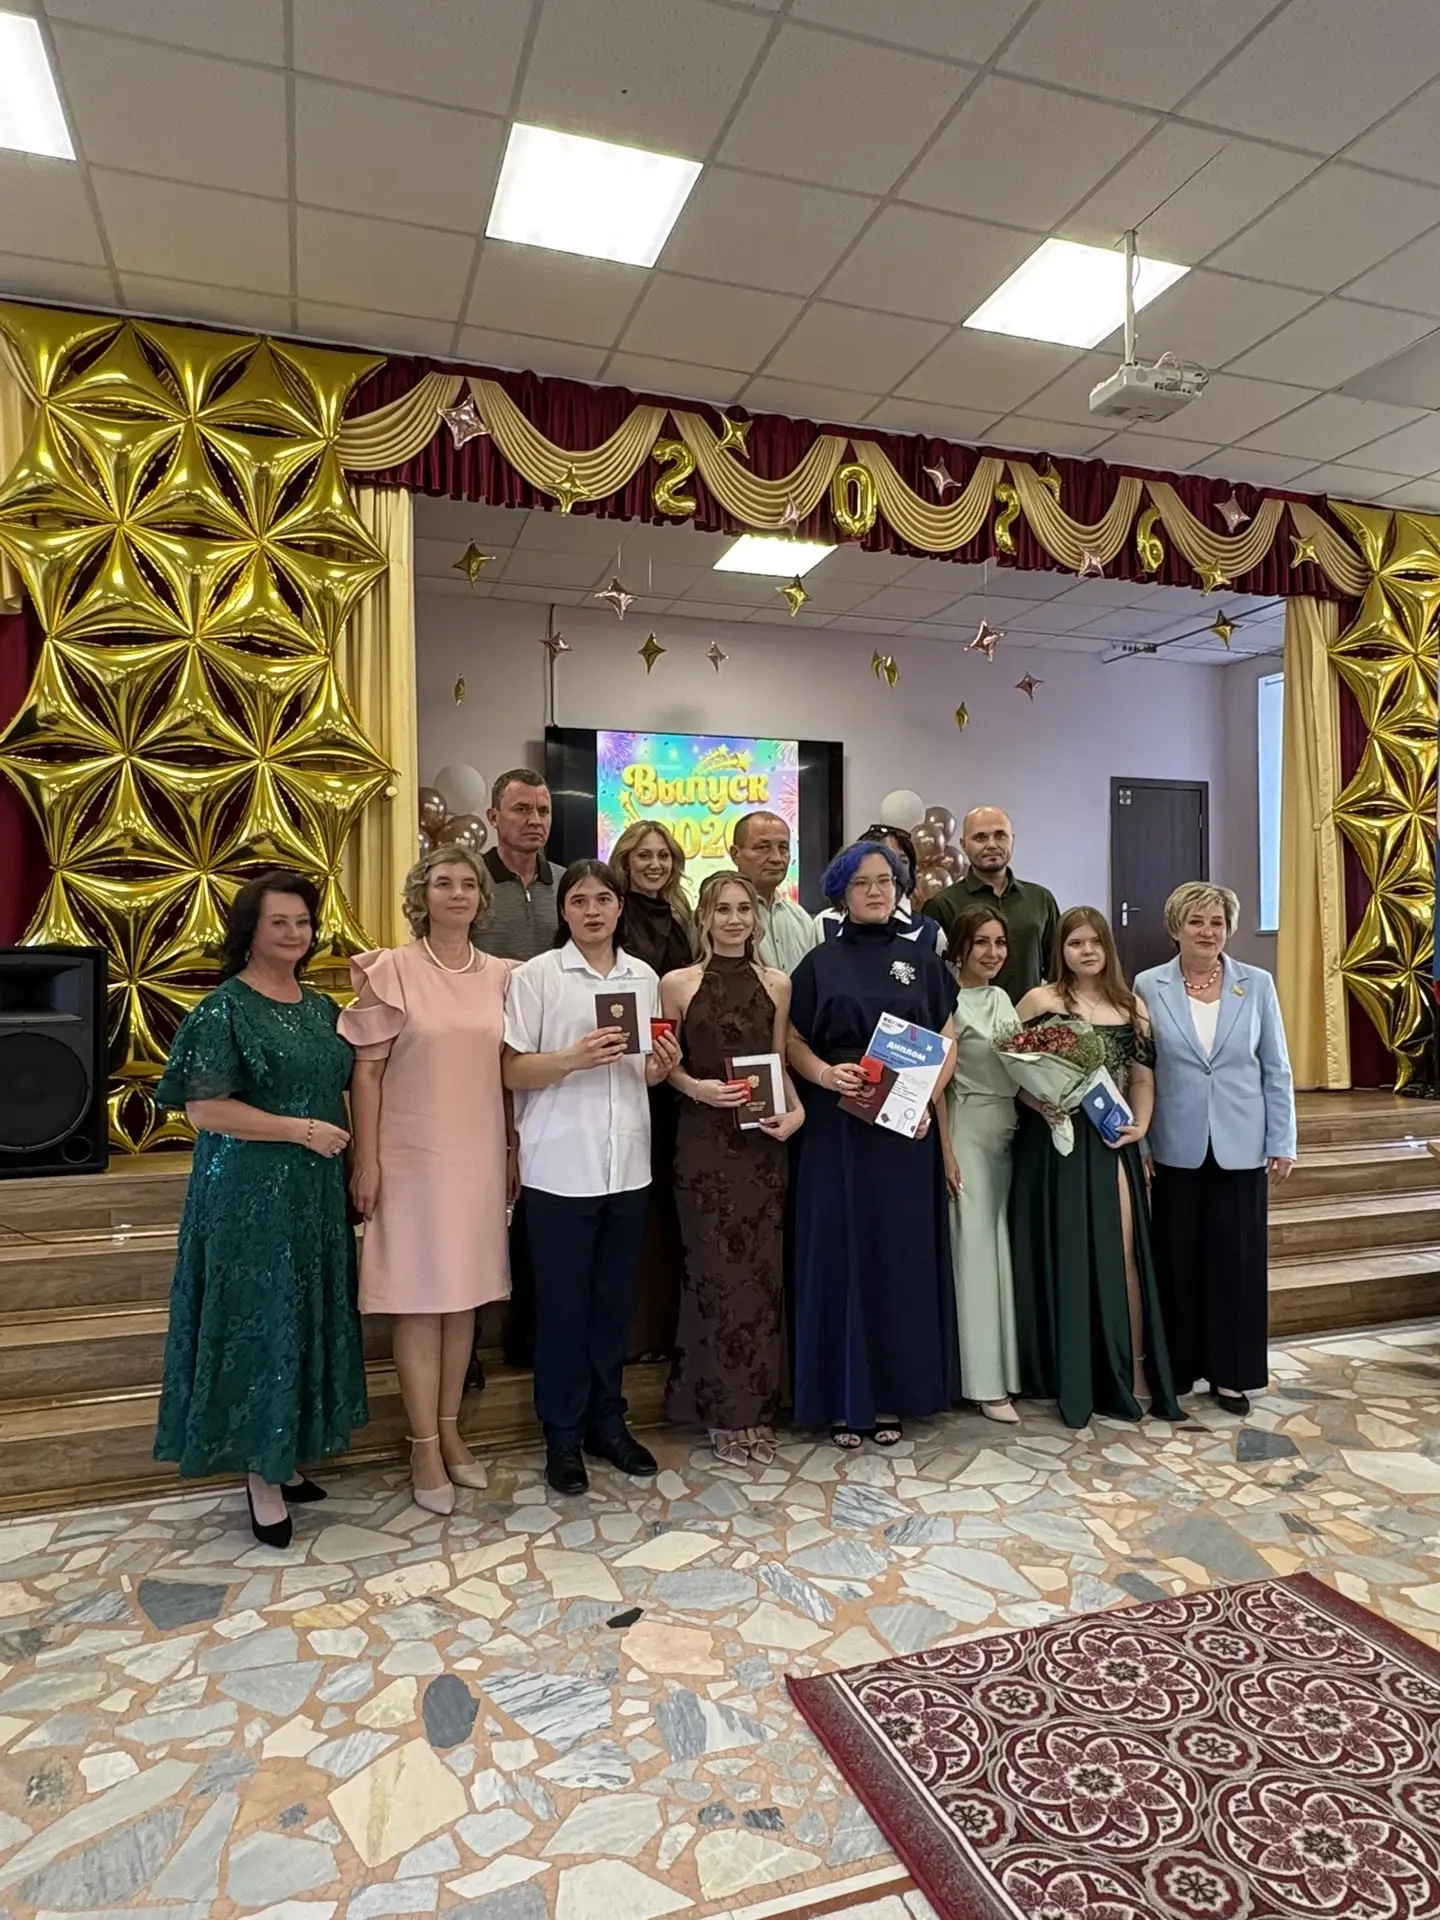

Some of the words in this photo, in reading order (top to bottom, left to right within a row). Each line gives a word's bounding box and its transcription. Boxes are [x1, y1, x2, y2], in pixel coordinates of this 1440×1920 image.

[652, 438, 697, 516] 2
[830, 462, 877, 536] 0
[1137, 505, 1164, 573] 6
[622, 764, 770, 814] Выпуск
